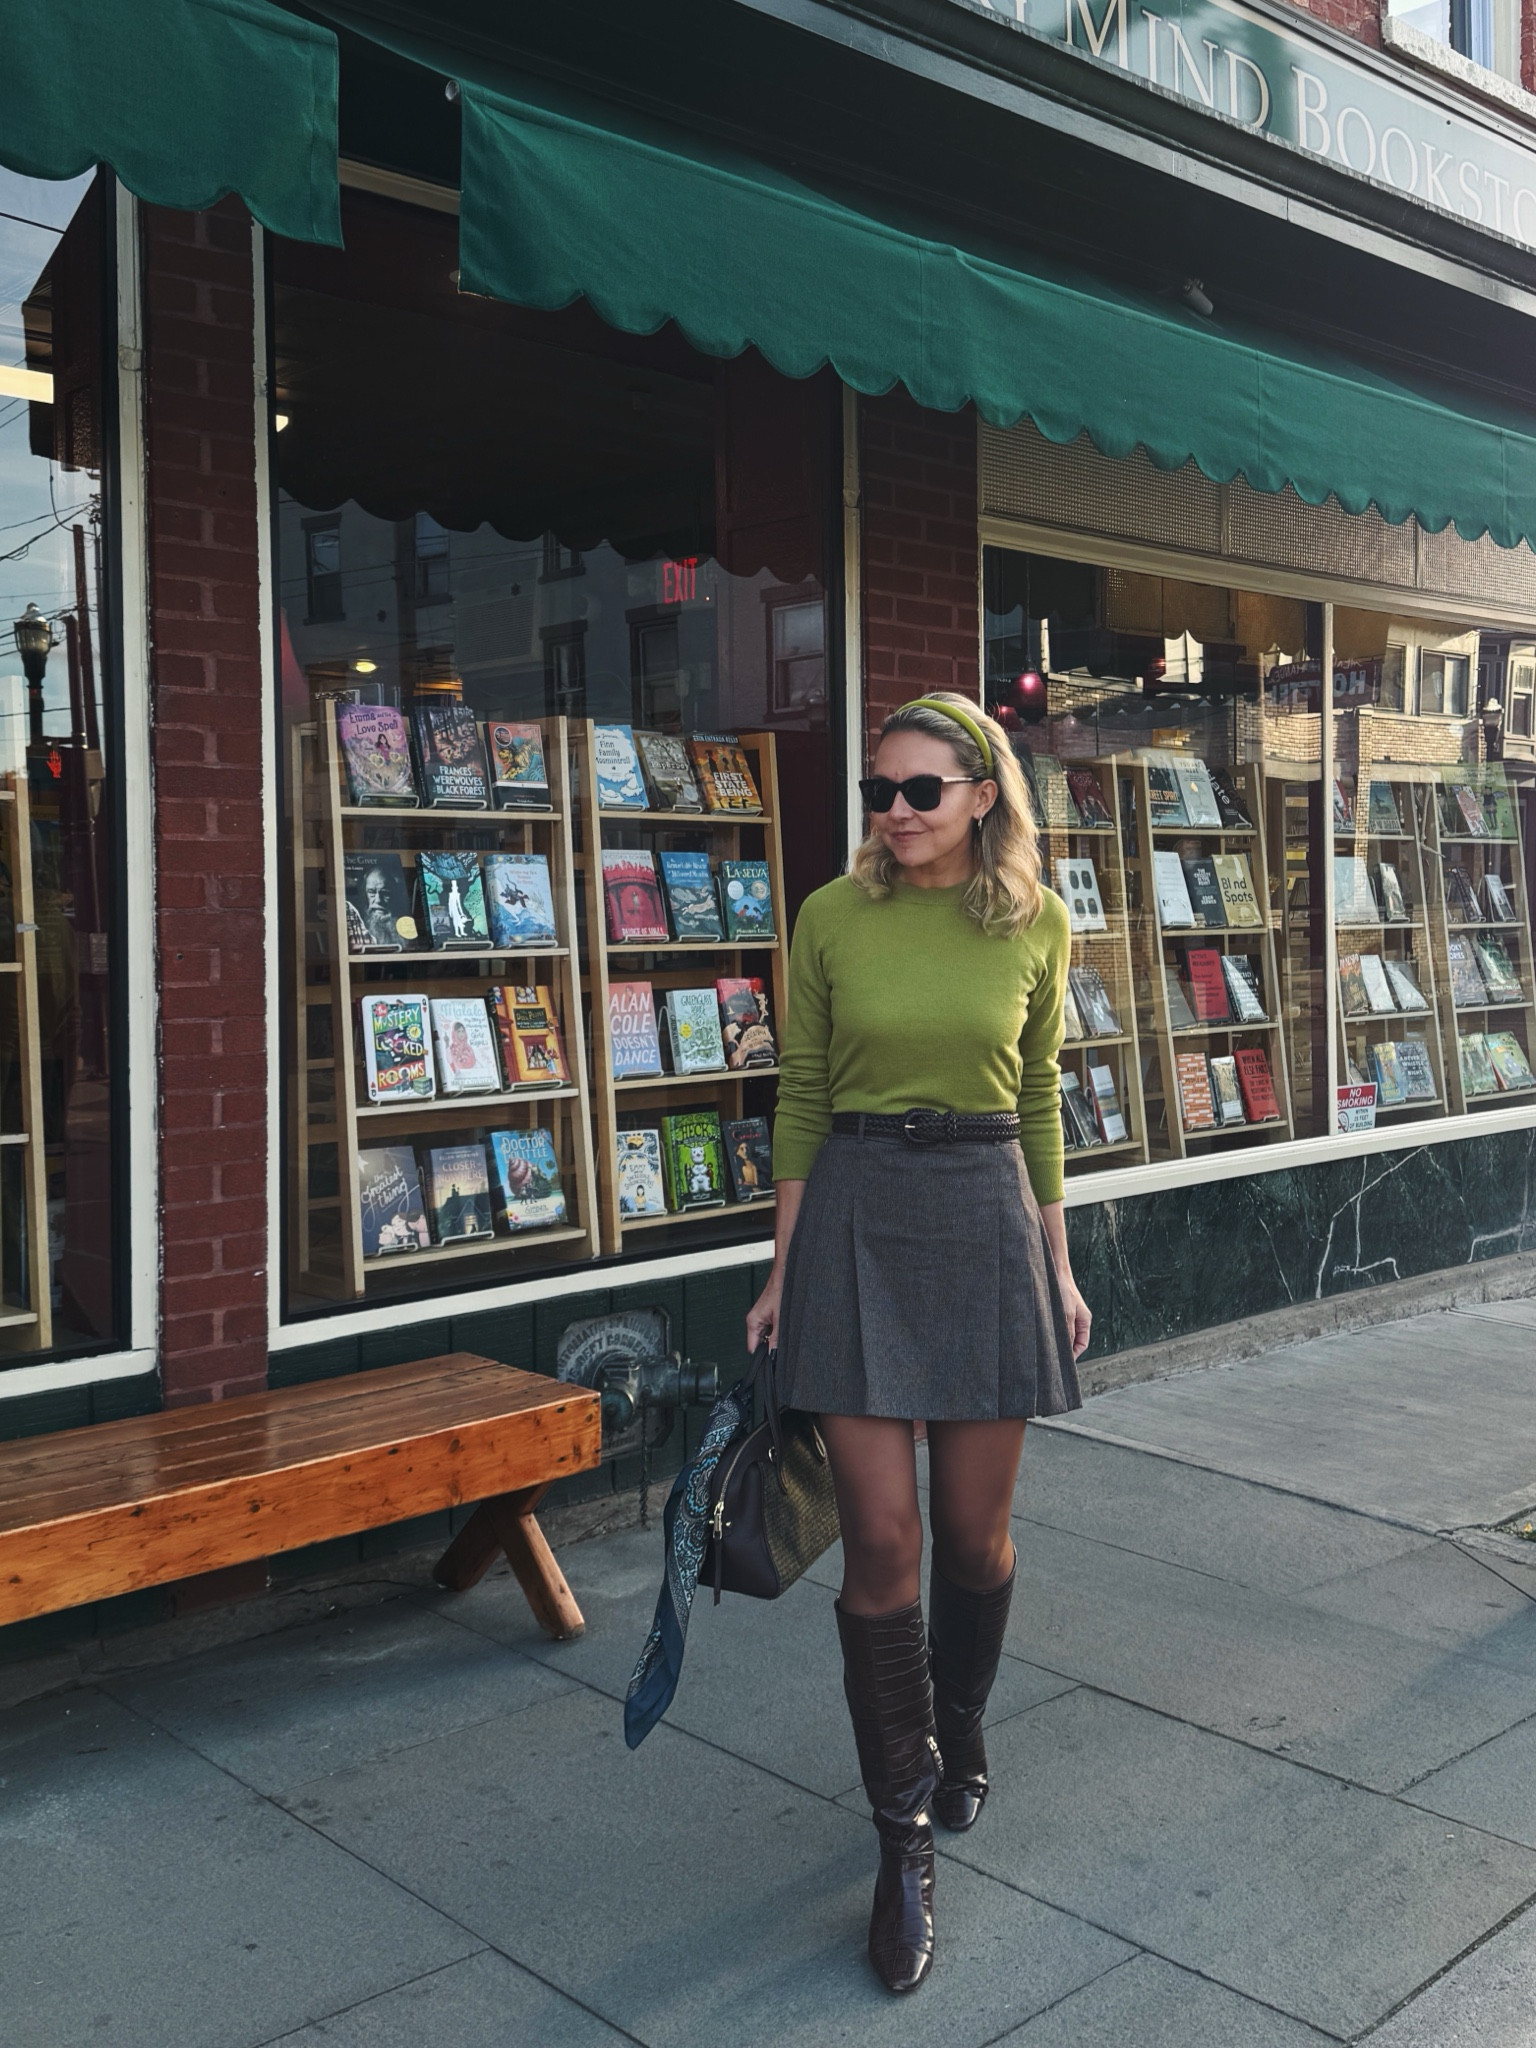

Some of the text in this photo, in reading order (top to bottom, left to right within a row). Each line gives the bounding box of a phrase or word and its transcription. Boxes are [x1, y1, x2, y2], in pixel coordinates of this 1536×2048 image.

[1057, 0, 1271, 130] MIND
[663, 557, 697, 604] EXIT
[349, 712, 376, 723] Emma
[356, 720, 398, 735] Love Spell
[598, 749, 620, 757] Family
[440, 766, 472, 776] FRANCES
[713, 772, 742, 780] FIRST
[433, 776, 483, 786] WEREWOLVES
[715, 780, 748, 788] STATE
[437, 786, 486, 796] BLACK FOREST
[720, 788, 753, 797] BEING
[358, 856, 377, 864] Giver
[727, 865, 740, 878] LA
[1224, 891, 1254, 905] Spots
[609, 992, 650, 1014] ALAN
[441, 1003, 485, 1019] Malala
[374, 1006, 420, 1031] MYSTERY
[611, 1013, 650, 1035] COLE
[376, 1034, 423, 1056] LOCKED
[613, 1034, 656, 1050] DOESN'T
[615, 1049, 657, 1066] DANCE
[1242, 1055, 1257, 1063] WHEN
[378, 1062, 425, 1088] ROOMS
[1350, 1088, 1361, 1097] NO
[1337, 1096, 1373, 1108] SMOKING
[502, 1136, 544, 1154] DOCTOR
[442, 1161, 476, 1171] CLOSER
[378, 1178, 420, 1213] thing
